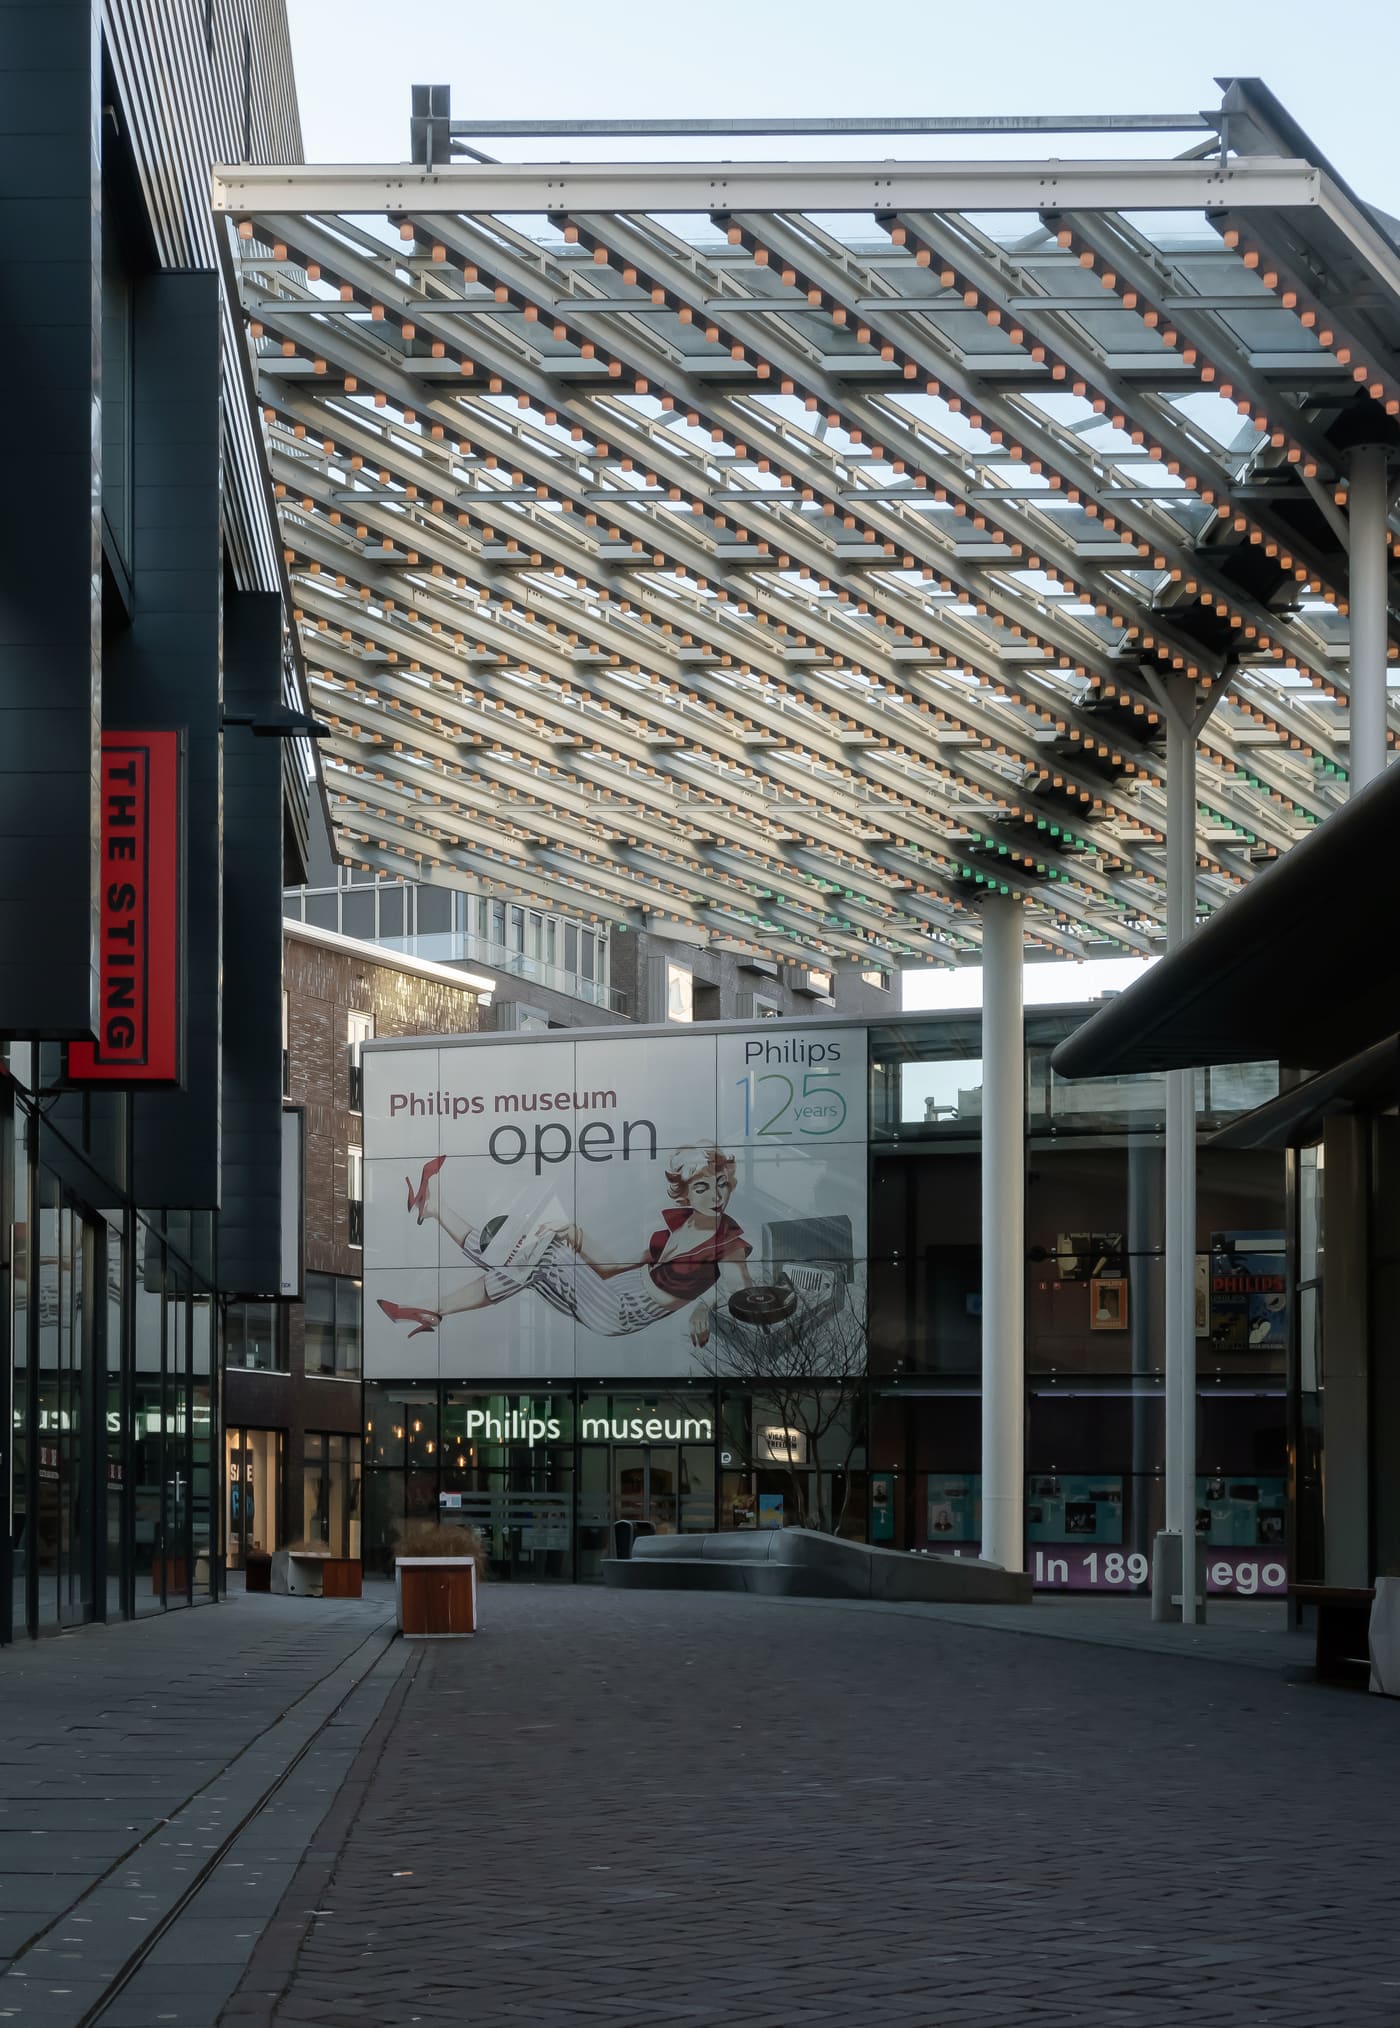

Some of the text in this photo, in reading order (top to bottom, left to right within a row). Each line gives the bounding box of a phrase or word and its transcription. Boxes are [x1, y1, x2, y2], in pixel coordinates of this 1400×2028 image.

[107, 760, 136, 1049] THE STING
[745, 1038, 841, 1068] Philips
[390, 1089, 617, 1119] Philips museum
[735, 1072, 847, 1136] 125
[793, 1105, 838, 1121] years
[488, 1119, 657, 1176] open
[1213, 1276, 1285, 1294] PHILIPS
[466, 1409, 713, 1448] Philips museum
[230, 1463, 253, 1483] SE
[1035, 1551, 1286, 1595] In 189 ego
